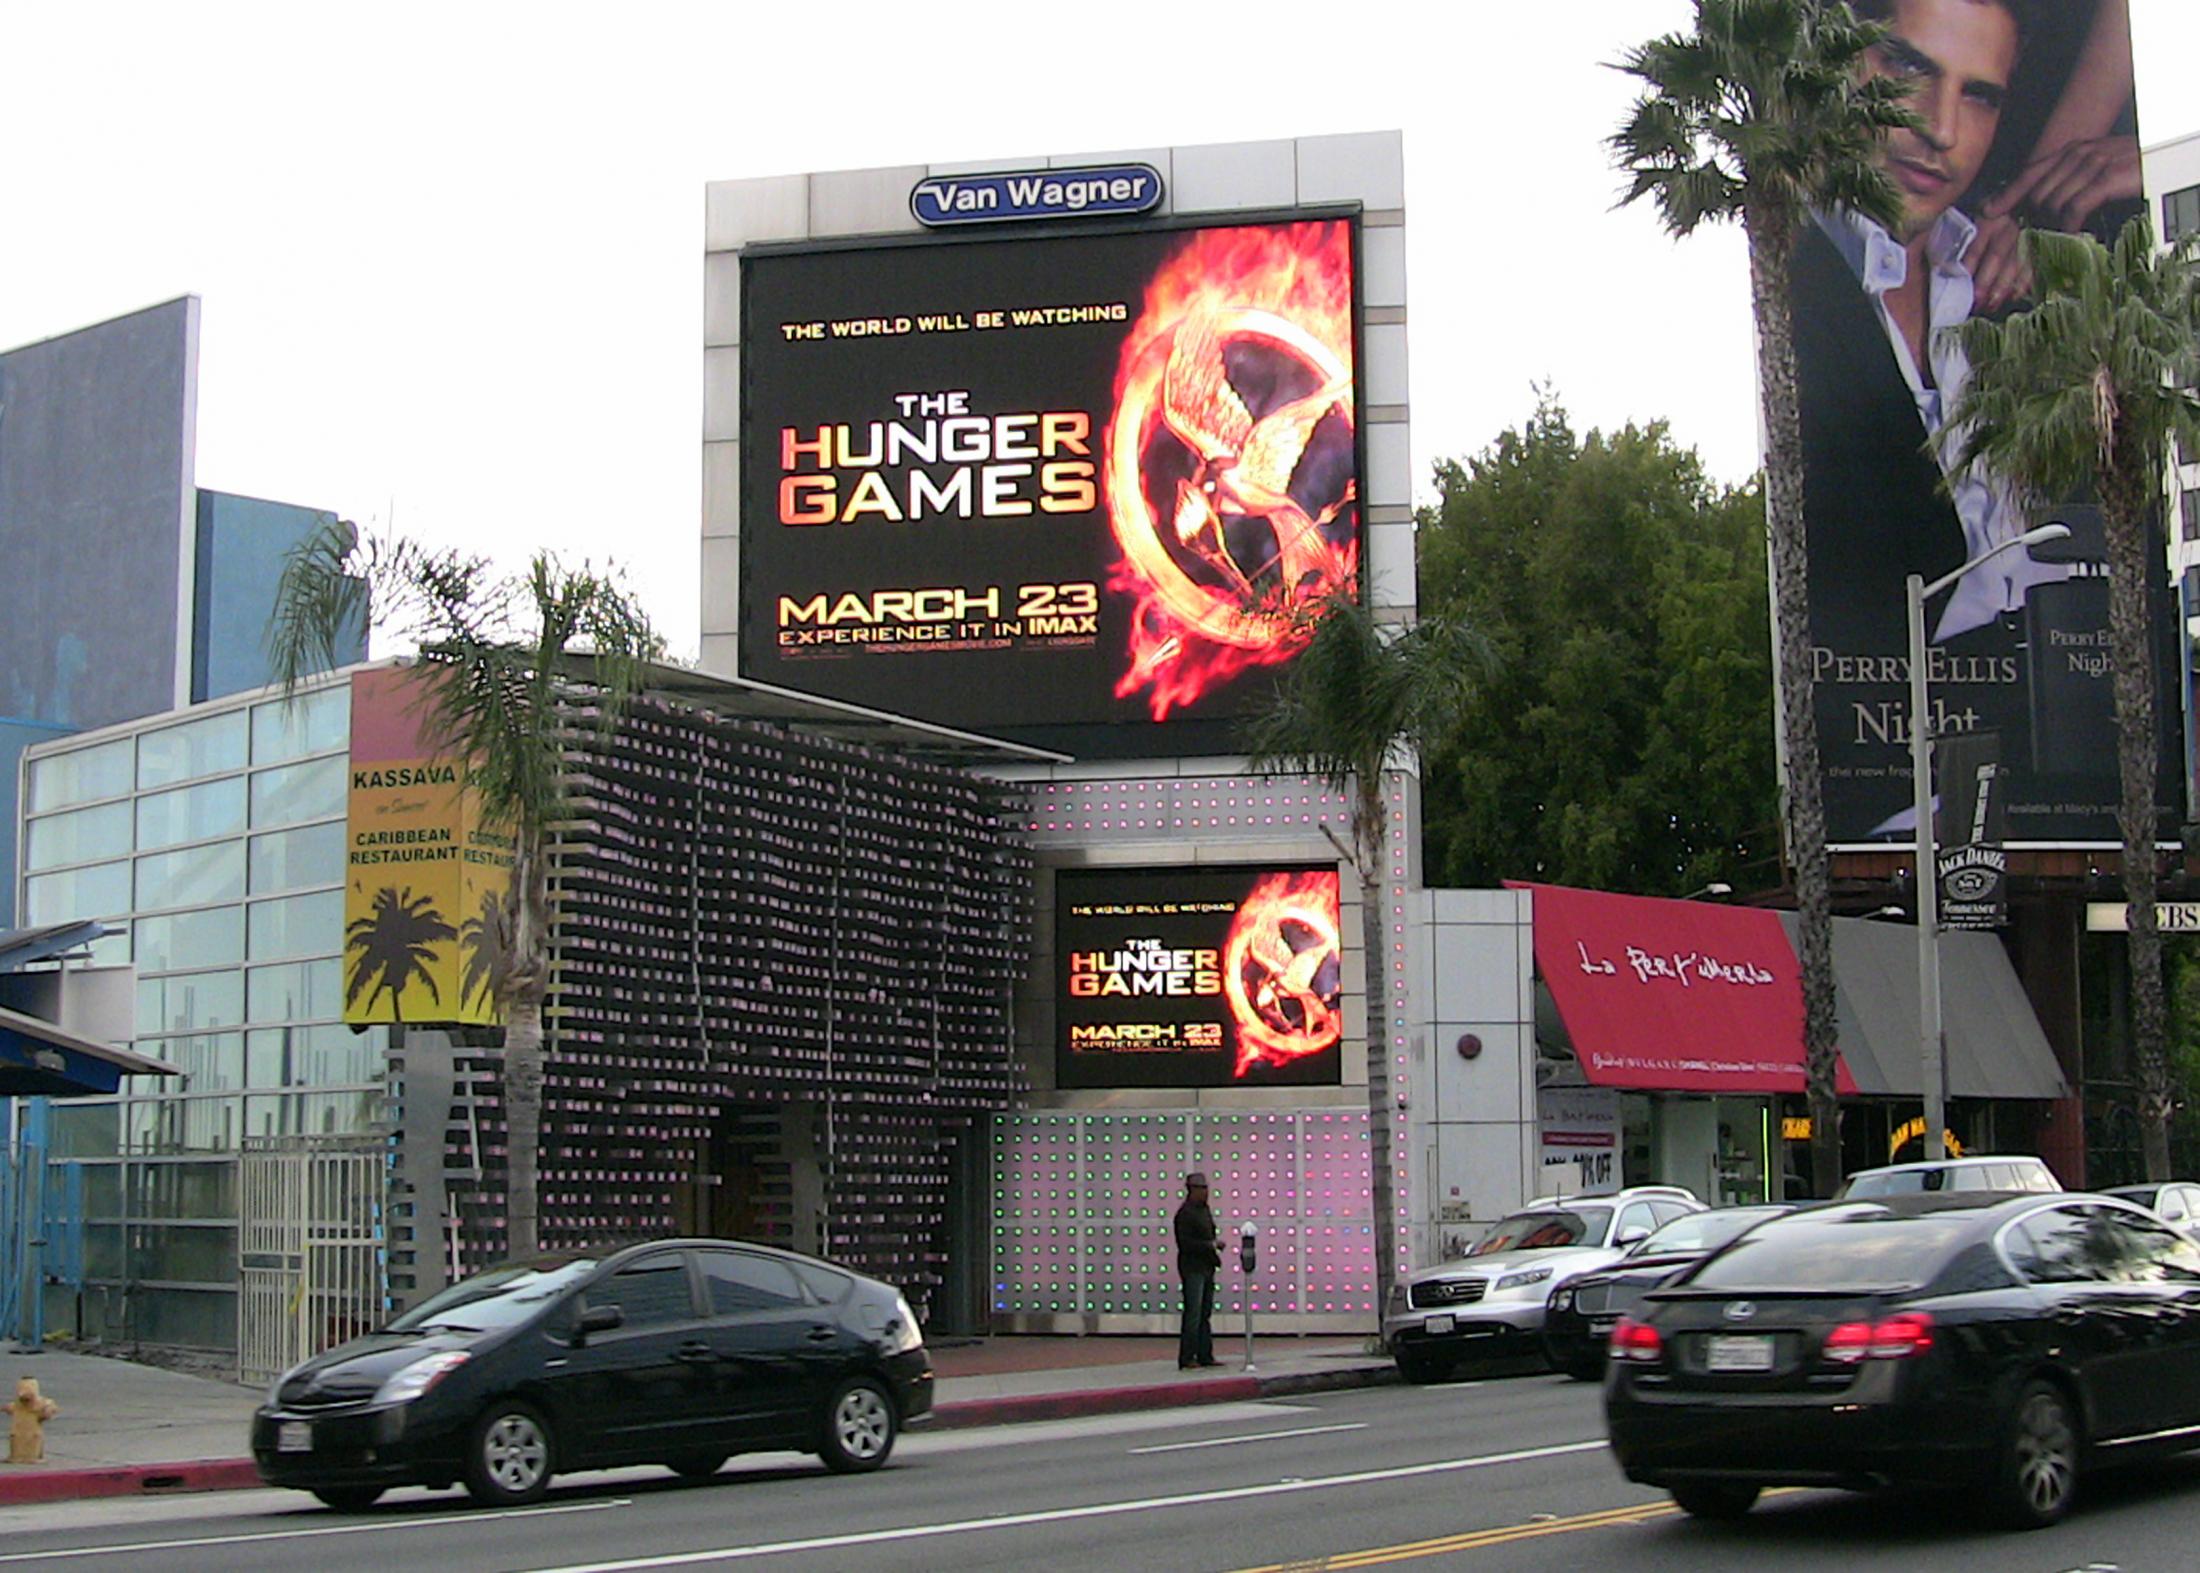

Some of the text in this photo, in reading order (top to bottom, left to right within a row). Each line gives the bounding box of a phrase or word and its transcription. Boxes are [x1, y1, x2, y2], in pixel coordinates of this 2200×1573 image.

[932, 176, 1148, 212] Van Wagner
[781, 303, 1128, 341] THE WORLD WILL BE WATCHING
[895, 391, 970, 417] THE
[781, 411, 1091, 471] HUNGER
[779, 461, 1097, 525] GAMES
[779, 583, 1099, 627] MARCH 23
[778, 615, 1098, 645] EXPERIENCE IT IN IMAX
[1810, 646, 2017, 683] PERRY ELLIS
[2067, 652, 2115, 678] Nigh
[1852, 697, 1981, 757] Niht
[353, 765, 456, 789] KASSAVA
[356, 828, 451, 846] CARIBBEAN
[350, 846, 459, 865] RESTAURANT
[2153, 905, 2199, 929] CBS
[1125, 938, 1162, 951] THE
[1576, 940, 1617, 975] La
[1071, 949, 1219, 973] HUNGER
[1069, 970, 1222, 997] GAMES
[1071, 1023, 1222, 1040] MARCH 23
